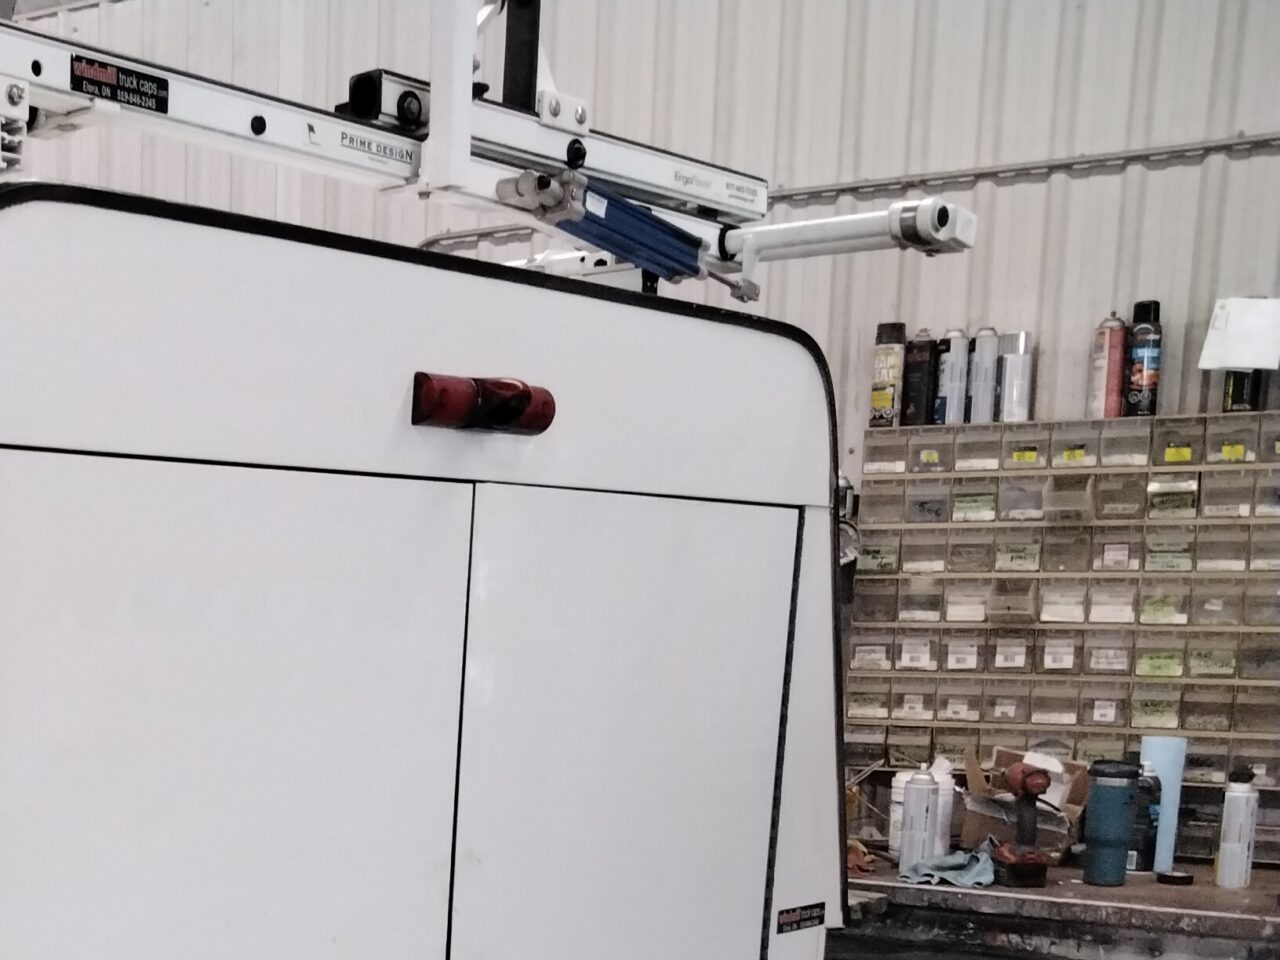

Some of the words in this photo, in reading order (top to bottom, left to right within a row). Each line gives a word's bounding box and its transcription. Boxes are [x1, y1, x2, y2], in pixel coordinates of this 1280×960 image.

[119, 71, 138, 90] truck
[101, 85, 111, 98] ON
[341, 132, 372, 151] PRIME
